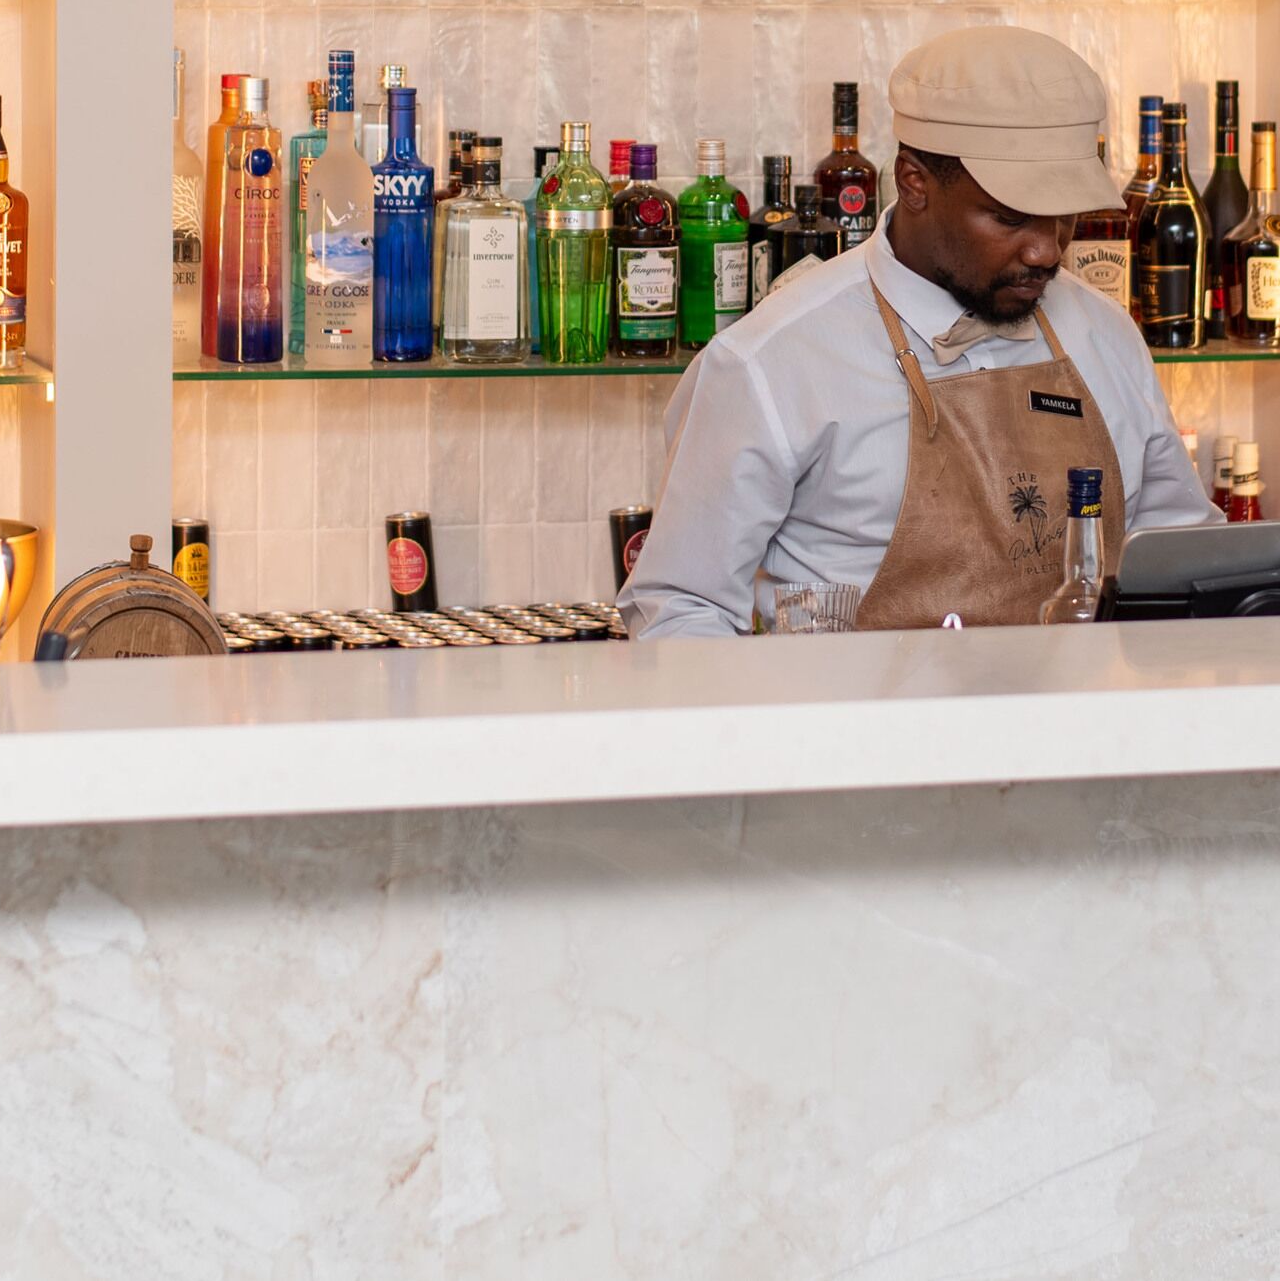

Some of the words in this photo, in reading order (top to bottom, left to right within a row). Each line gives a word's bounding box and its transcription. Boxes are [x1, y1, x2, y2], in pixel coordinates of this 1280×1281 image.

[373, 174, 426, 196] SKYY
[382, 198, 415, 206] VODKA
[1076, 251, 1097, 269] JACK
[306, 285, 328, 297] GREY
[331, 285, 370, 297] GOOSE
[633, 285, 670, 294] ROYALE
[1040, 397, 1076, 411] YAMKELA
[1008, 472, 1038, 486] THE
[1081, 503, 1102, 515] APERO
